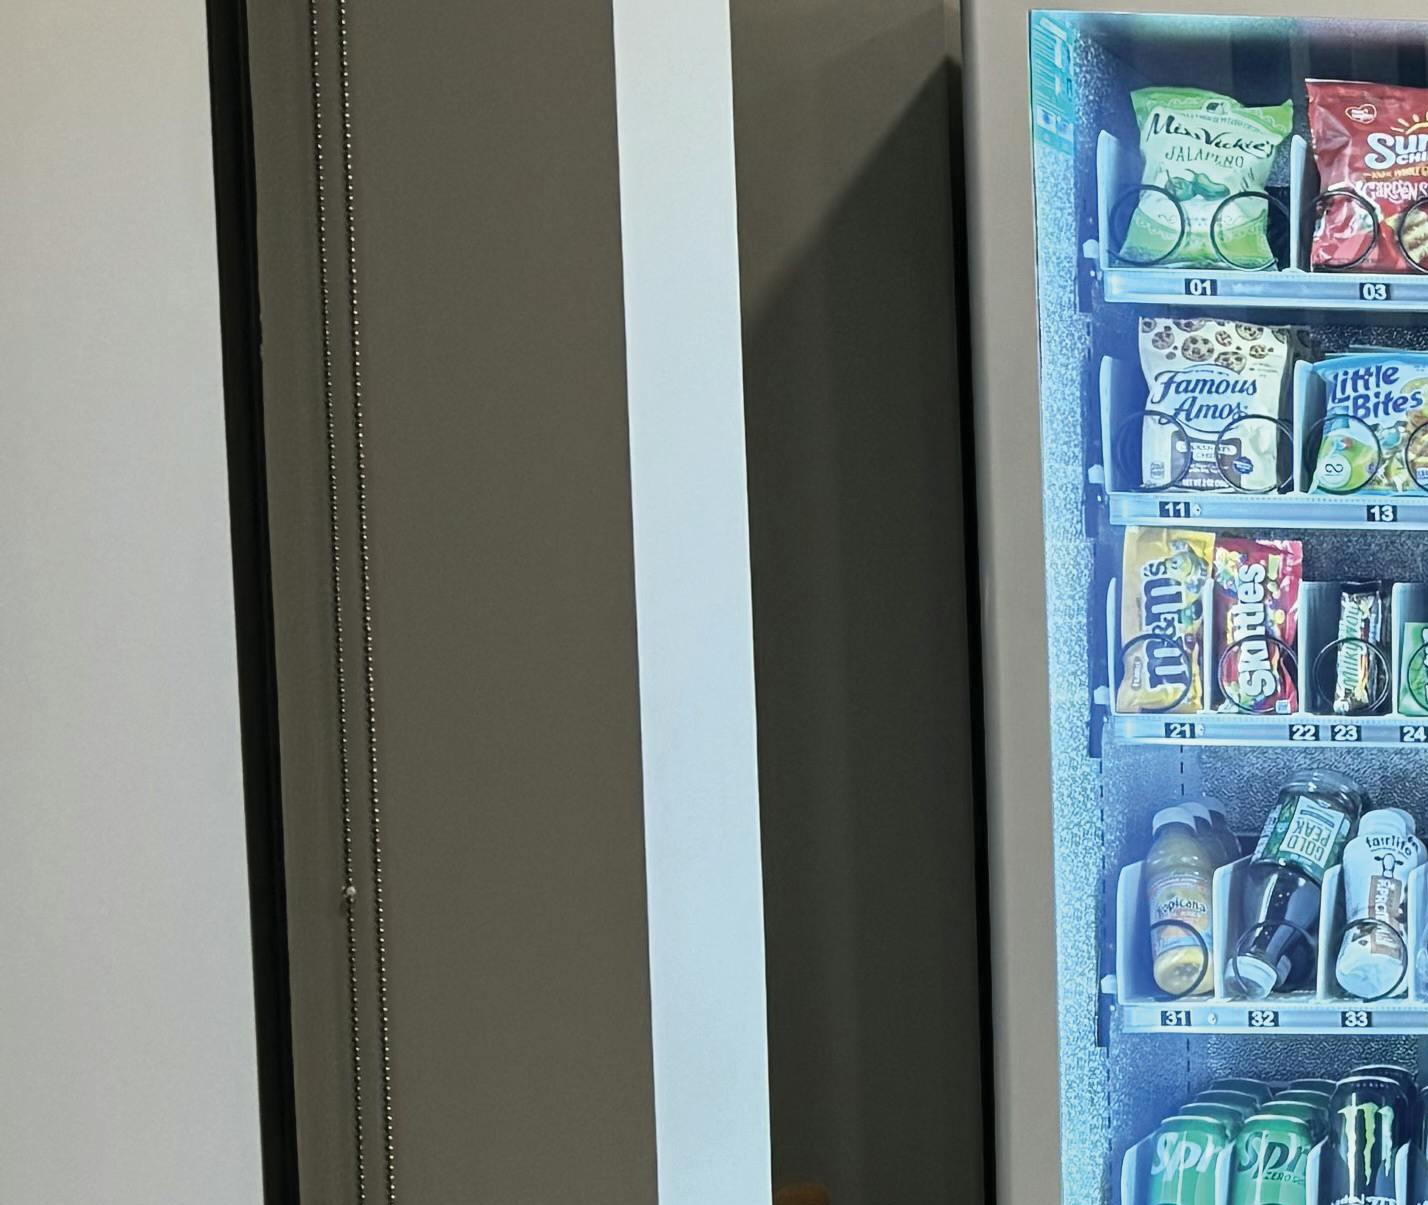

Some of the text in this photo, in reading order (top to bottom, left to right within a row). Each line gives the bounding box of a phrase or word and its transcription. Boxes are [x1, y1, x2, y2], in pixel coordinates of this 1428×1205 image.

[1190, 280, 1212, 296] 01
[1363, 282, 1387, 299] 03
[1151, 370, 1258, 405] Famous
[1331, 365, 1400, 405] Little
[1168, 397, 1250, 424] Amos
[1352, 390, 1424, 419] Bites
[1164, 503, 1185, 515] 11
[1369, 505, 1395, 522] 13
[1233, 563, 1278, 698] Skittles
[1169, 723, 1191, 739] 21
[1290, 724, 1314, 741] 22
[1333, 726, 1359, 741] 23
[1402, 726, 1428, 742] 24
[1292, 820, 1333, 848] PEAK
[1287, 835, 1325, 862] GOLD
[1166, 1010, 1187, 1026] 31
[1251, 1010, 1275, 1027] 32
[1345, 1010, 1369, 1027] 33
